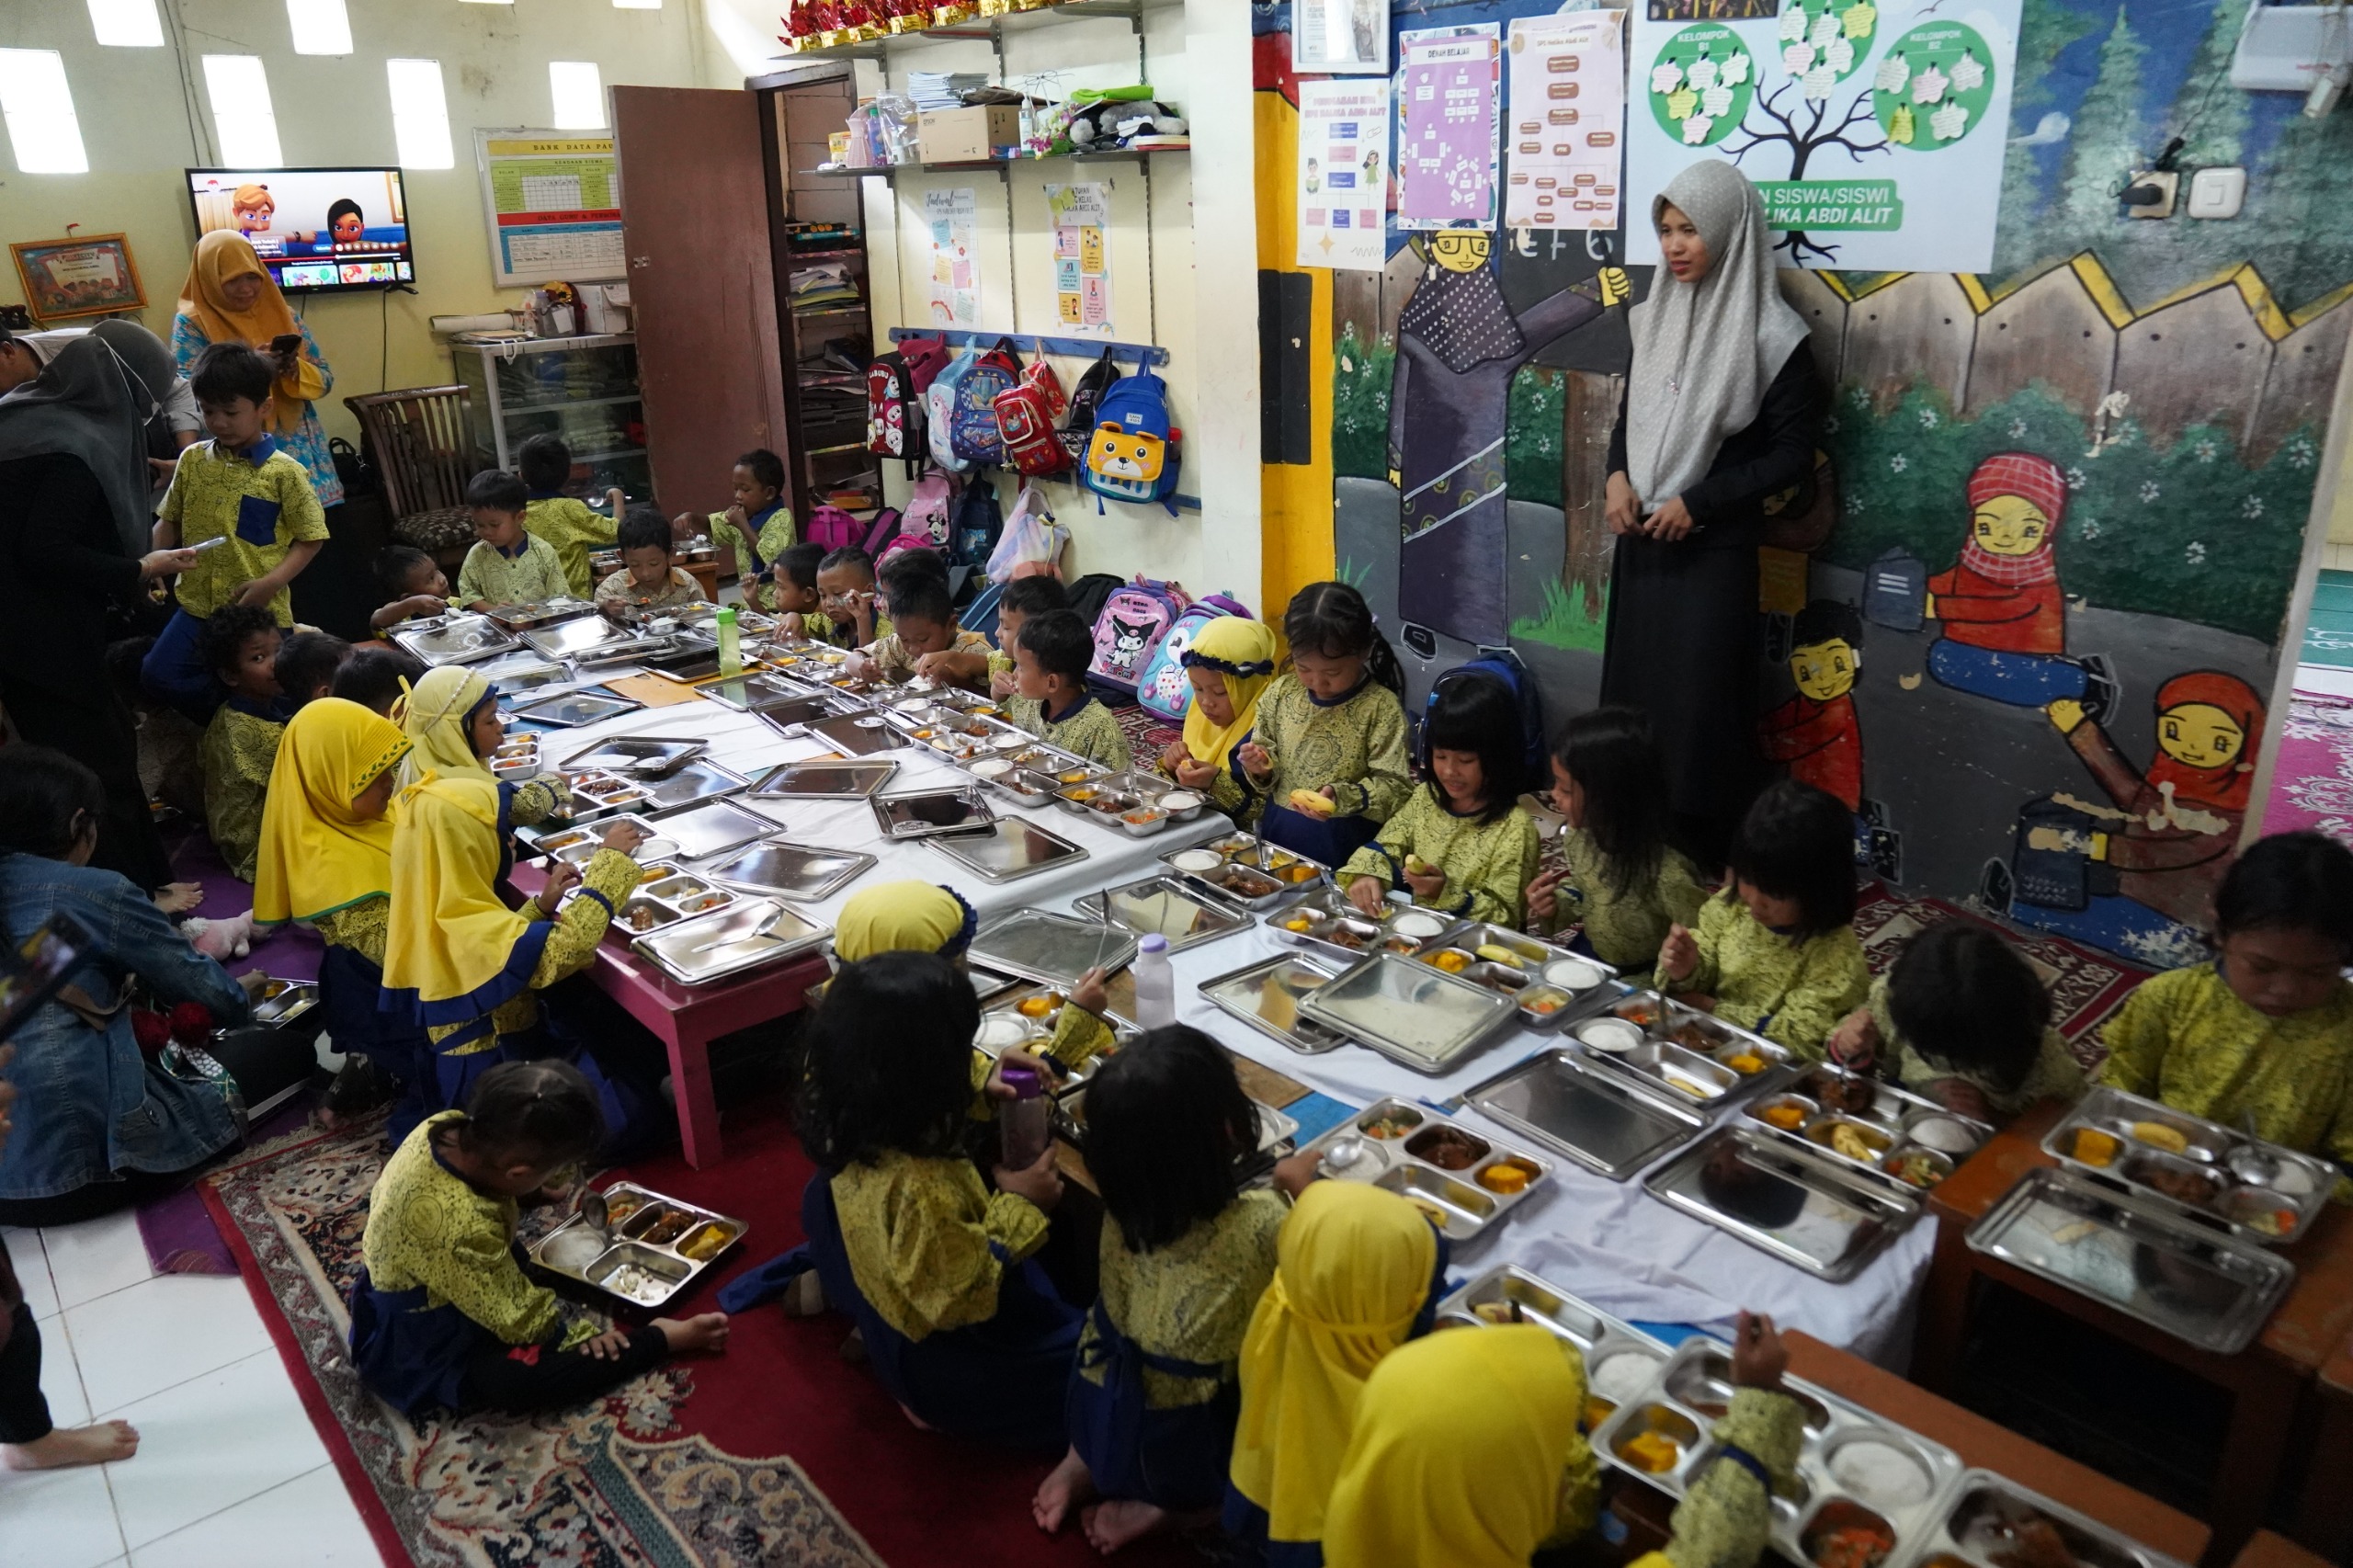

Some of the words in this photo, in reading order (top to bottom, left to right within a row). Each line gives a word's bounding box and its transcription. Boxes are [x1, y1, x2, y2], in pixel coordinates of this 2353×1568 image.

[1677, 29, 1730, 42] KELOMPOK
[1698, 41, 1710, 51] B1
[926, 190, 953, 208] Jadwal
[1774, 187, 1889, 204] SISWA/SISWI
[1765, 208, 1802, 223] LIKA
[1805, 207, 1847, 223] ABDI
[1849, 207, 1894, 223] ALIT
[869, 369, 889, 380] LABUBU
